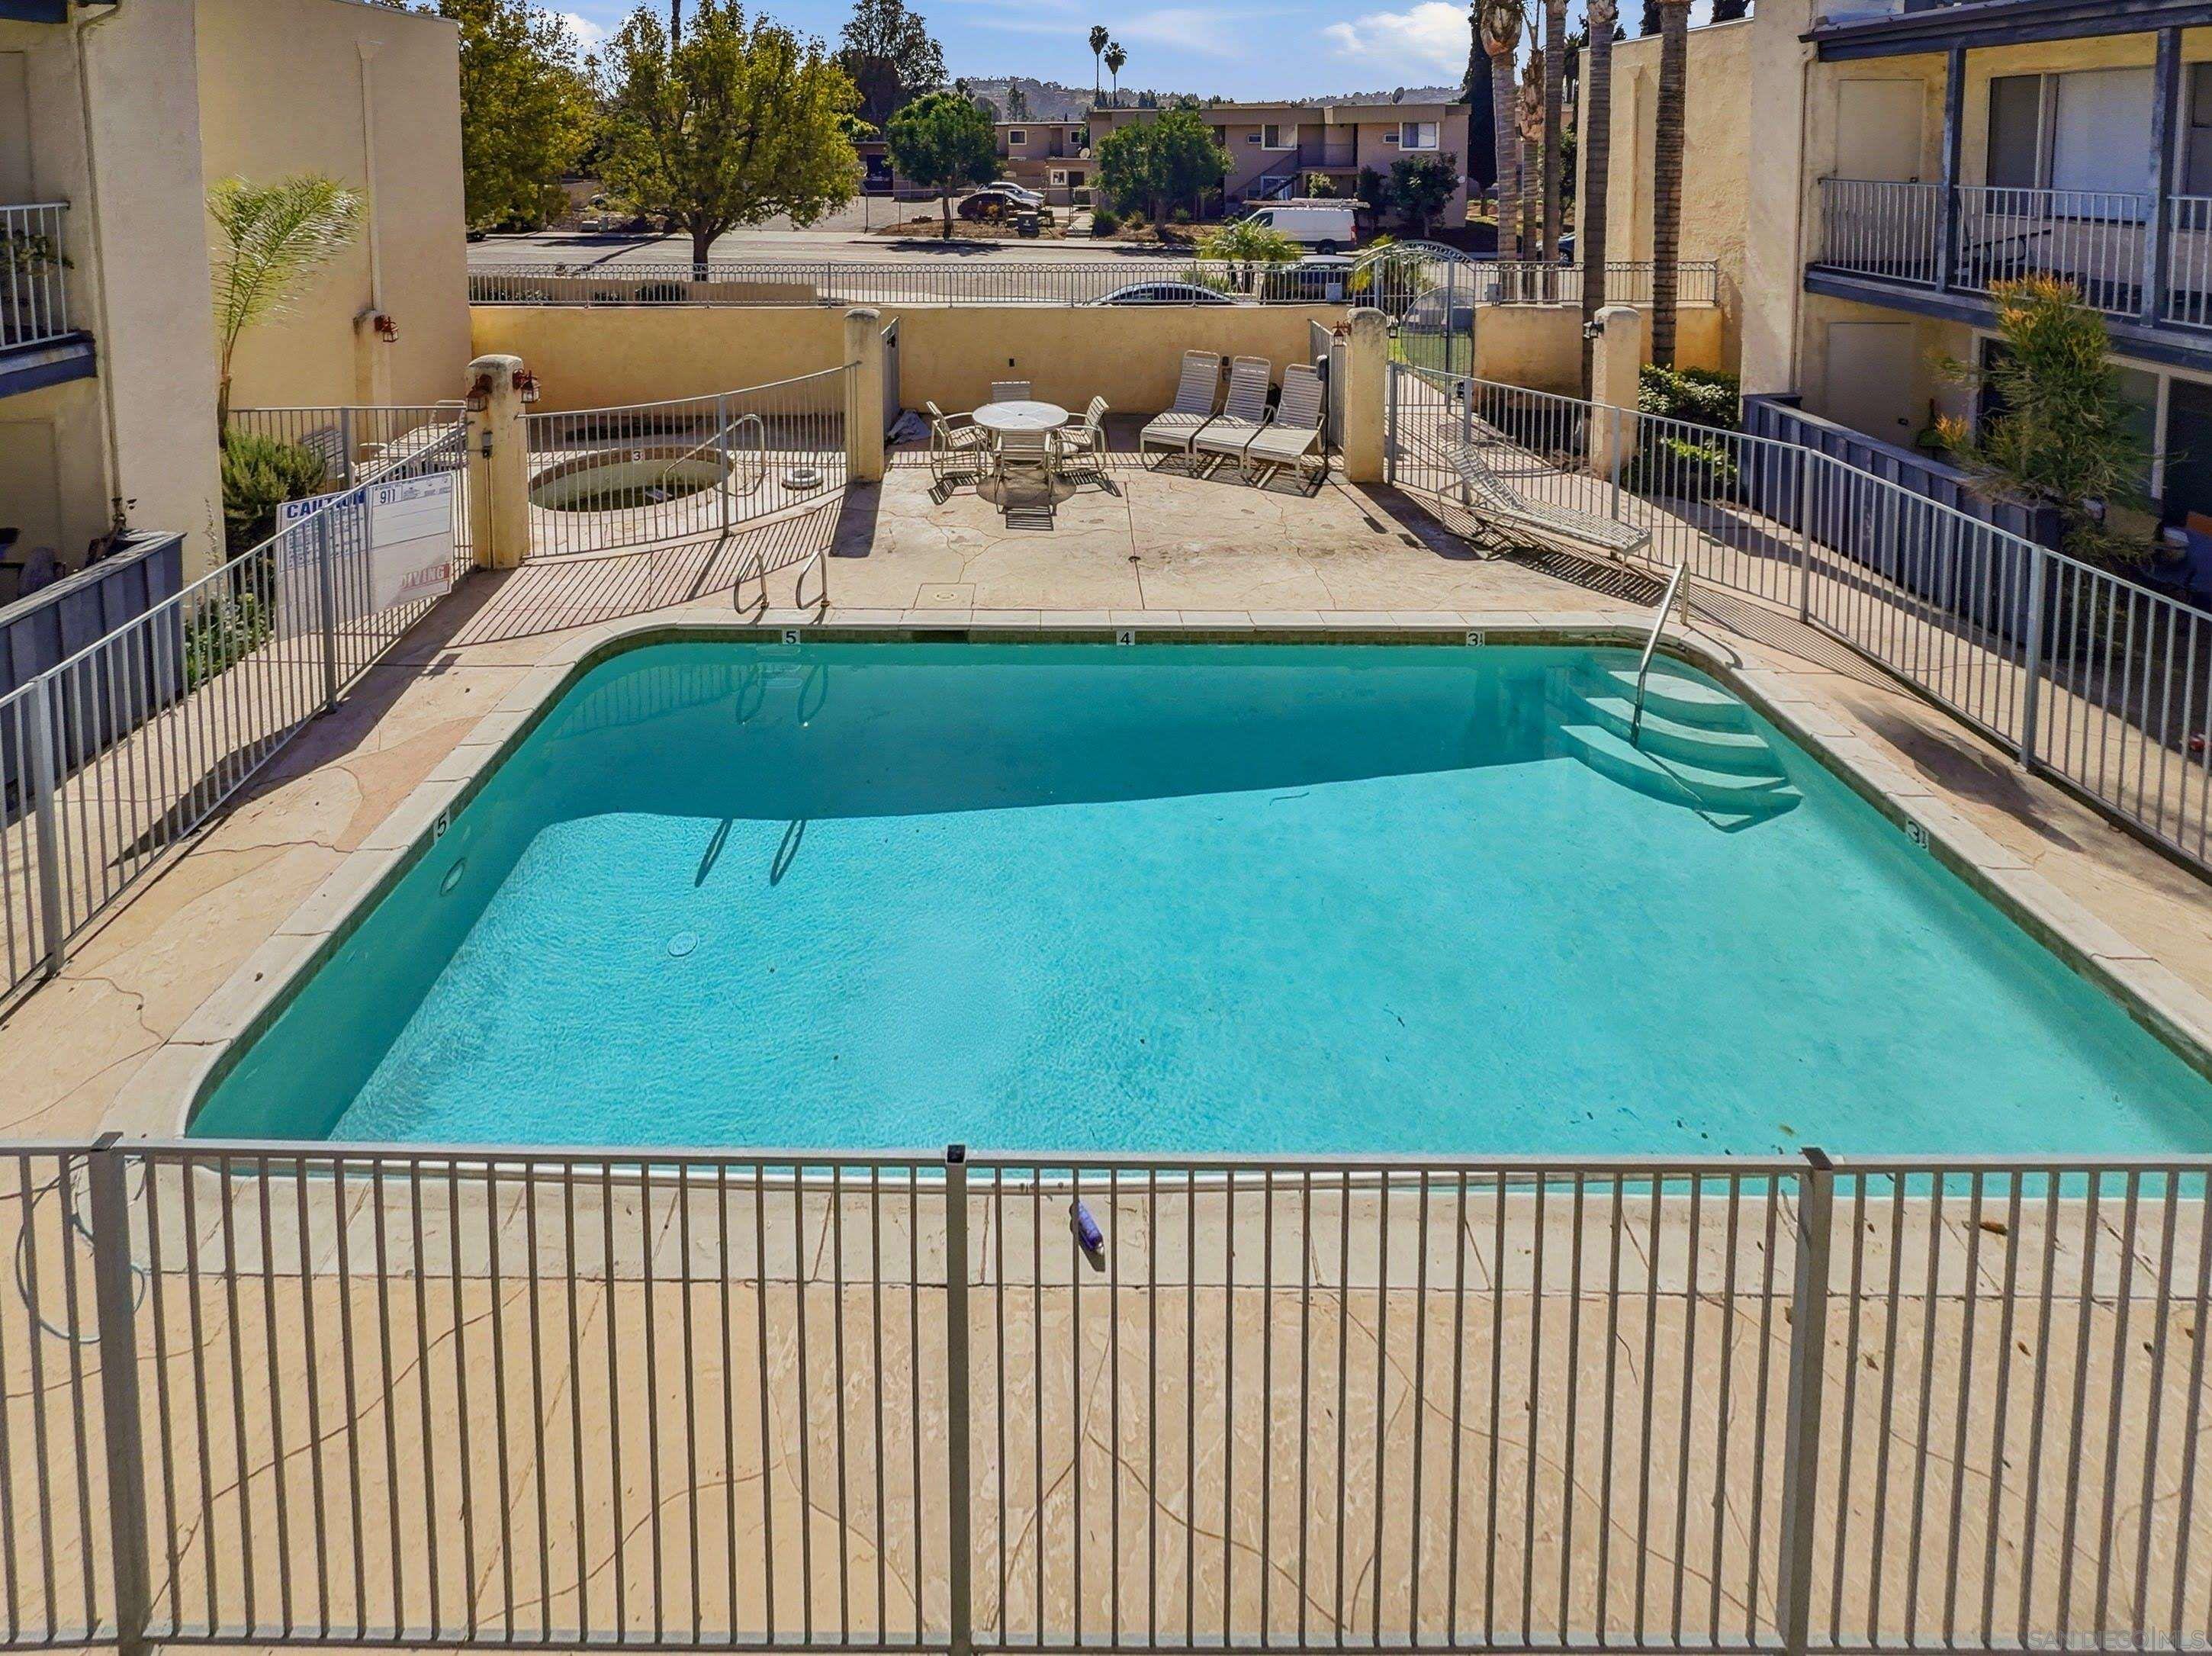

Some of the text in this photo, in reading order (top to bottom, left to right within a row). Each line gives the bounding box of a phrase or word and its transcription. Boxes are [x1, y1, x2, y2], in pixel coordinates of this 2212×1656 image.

[380, 489, 395, 503] 911
[786, 630, 796, 645] 5
[1120, 632, 1131, 645] 4
[437, 812, 447, 838] 5
